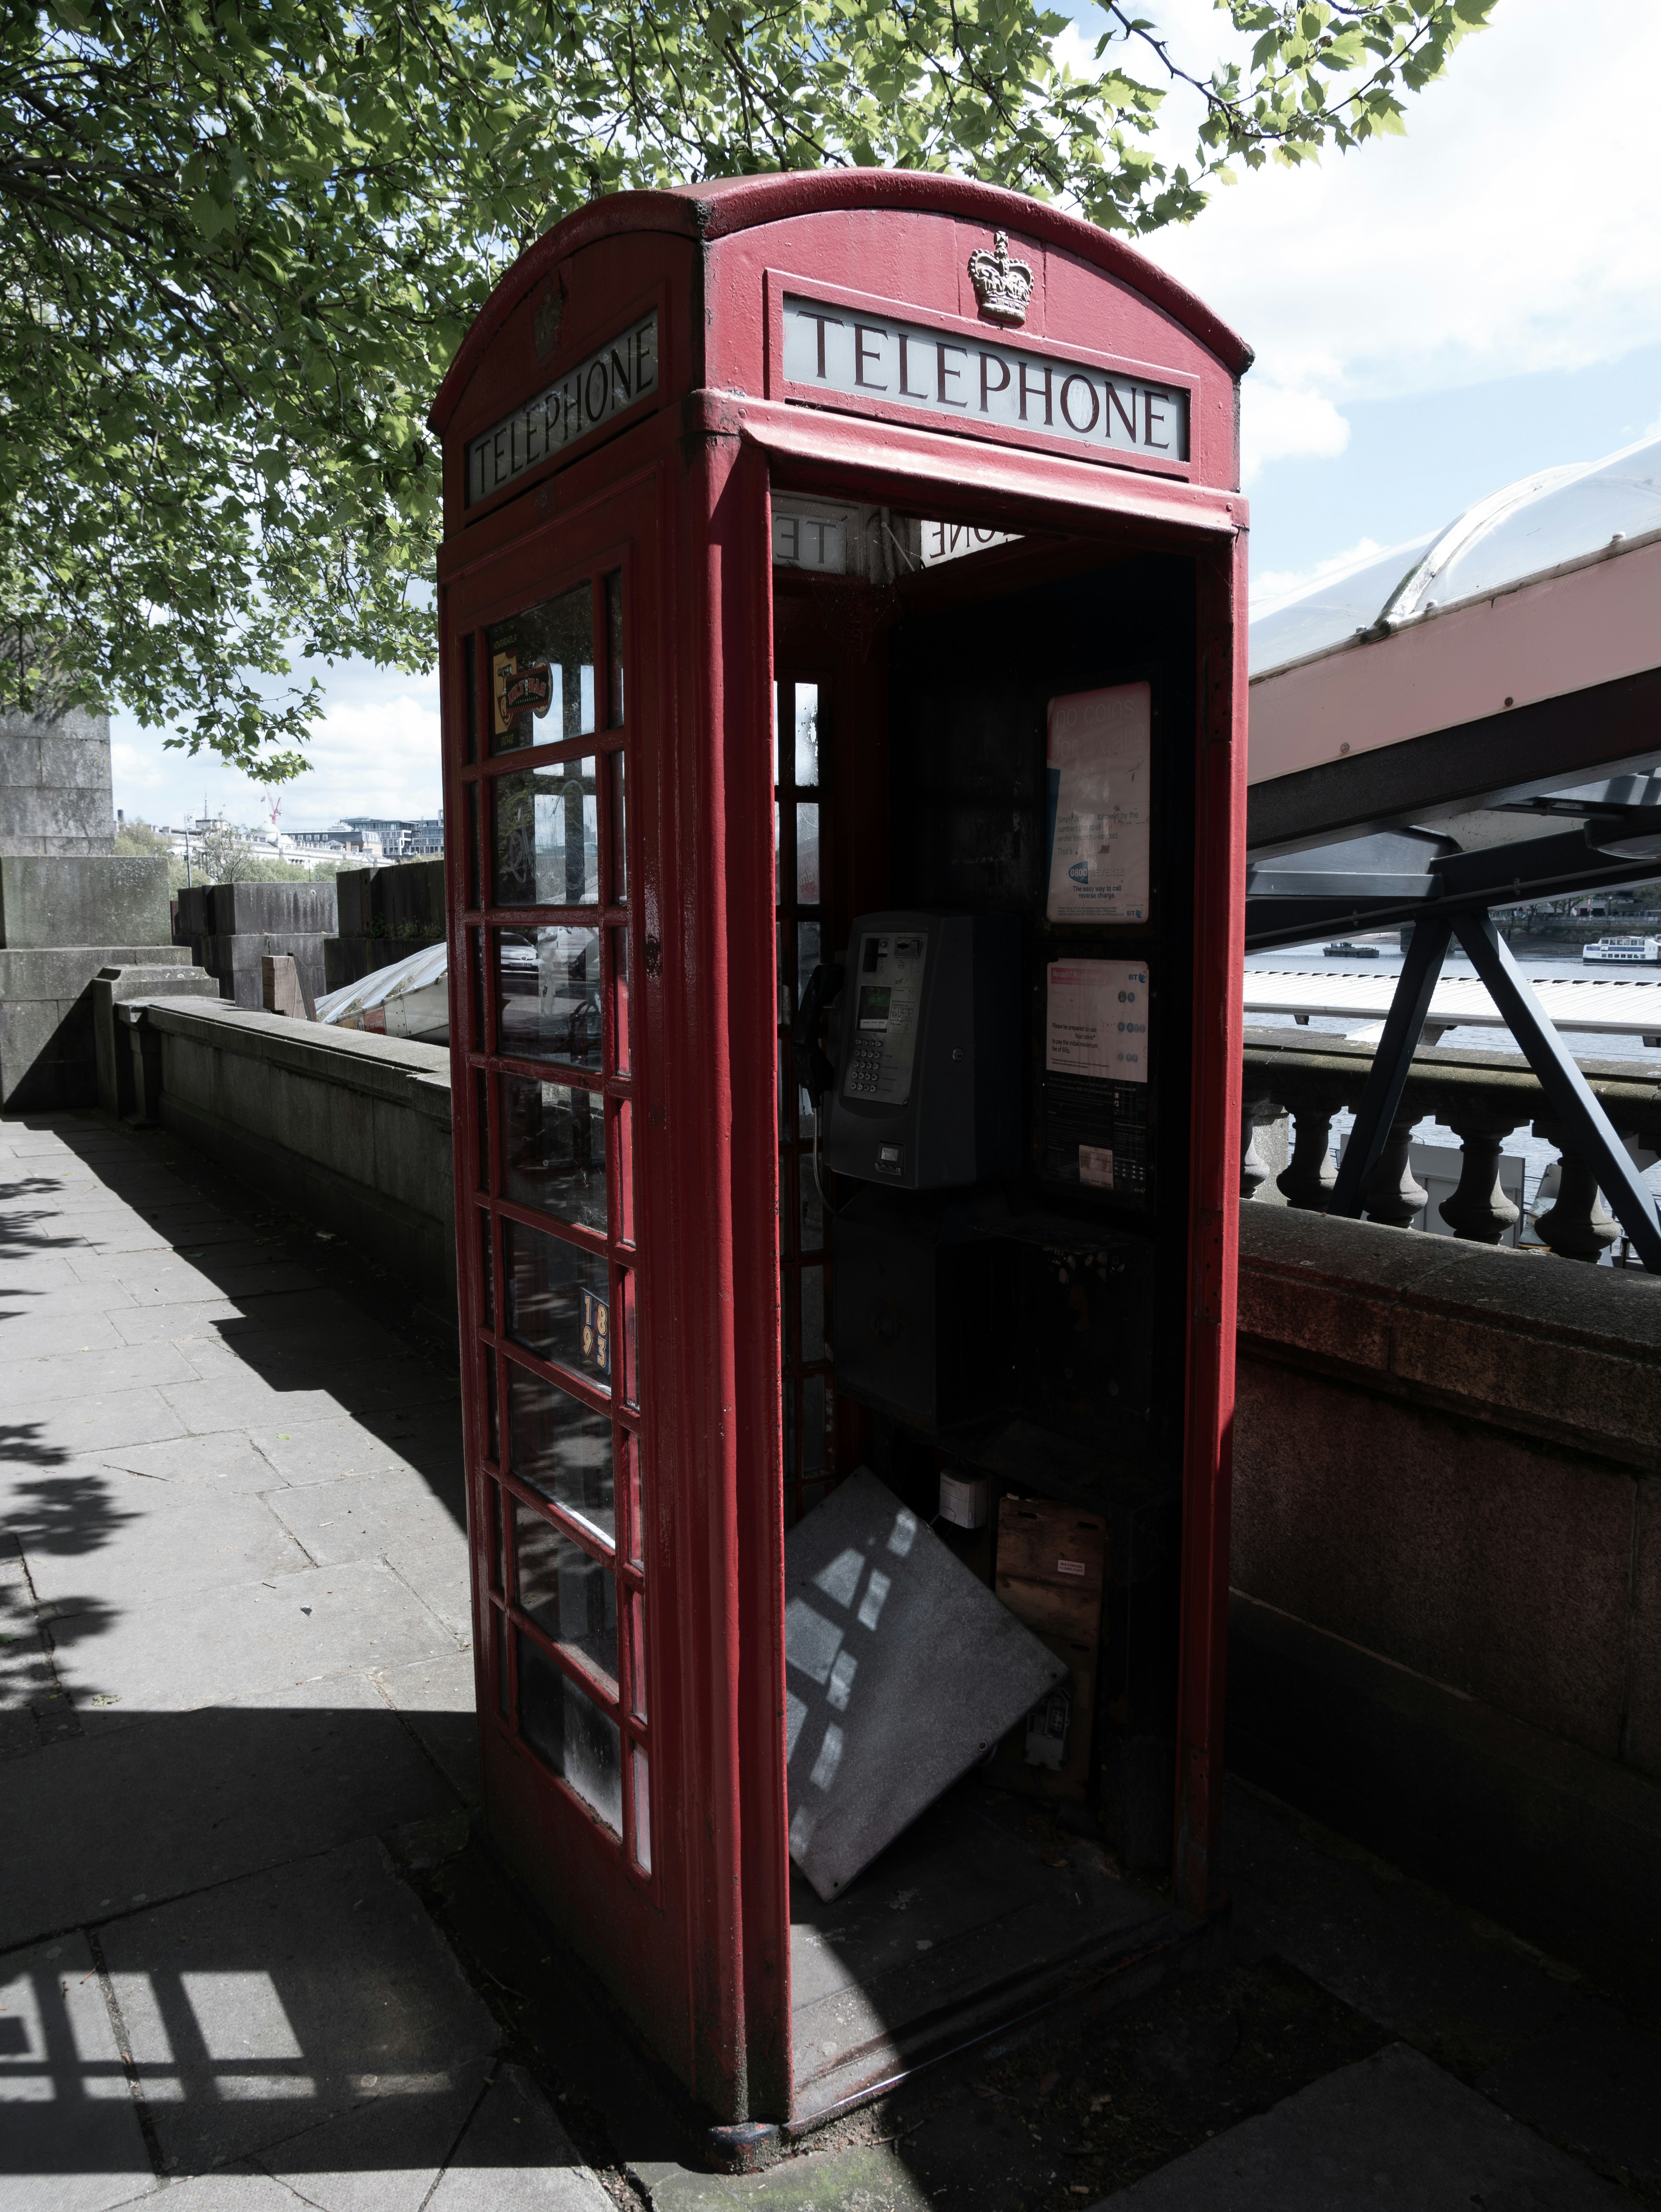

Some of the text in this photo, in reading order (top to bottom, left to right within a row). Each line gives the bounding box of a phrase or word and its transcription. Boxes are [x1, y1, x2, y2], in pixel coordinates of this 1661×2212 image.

[796, 310, 1170, 449] TELEPHONE
[475, 321, 654, 494] TELEPHONE
[493, 633, 517, 651] MONTAGNOLA
[507, 677, 547, 705] ULTRAS
[1055, 696, 1134, 728] no coins
[501, 733, 514, 746] 00142
[1055, 736, 1078, 759] for
[1097, 812, 1119, 820] followed
[1121, 812, 1128, 820] by
[1089, 823, 1101, 832] spell
[1057, 847, 1072, 856] That's
[1070, 868, 1087, 877] 0800
